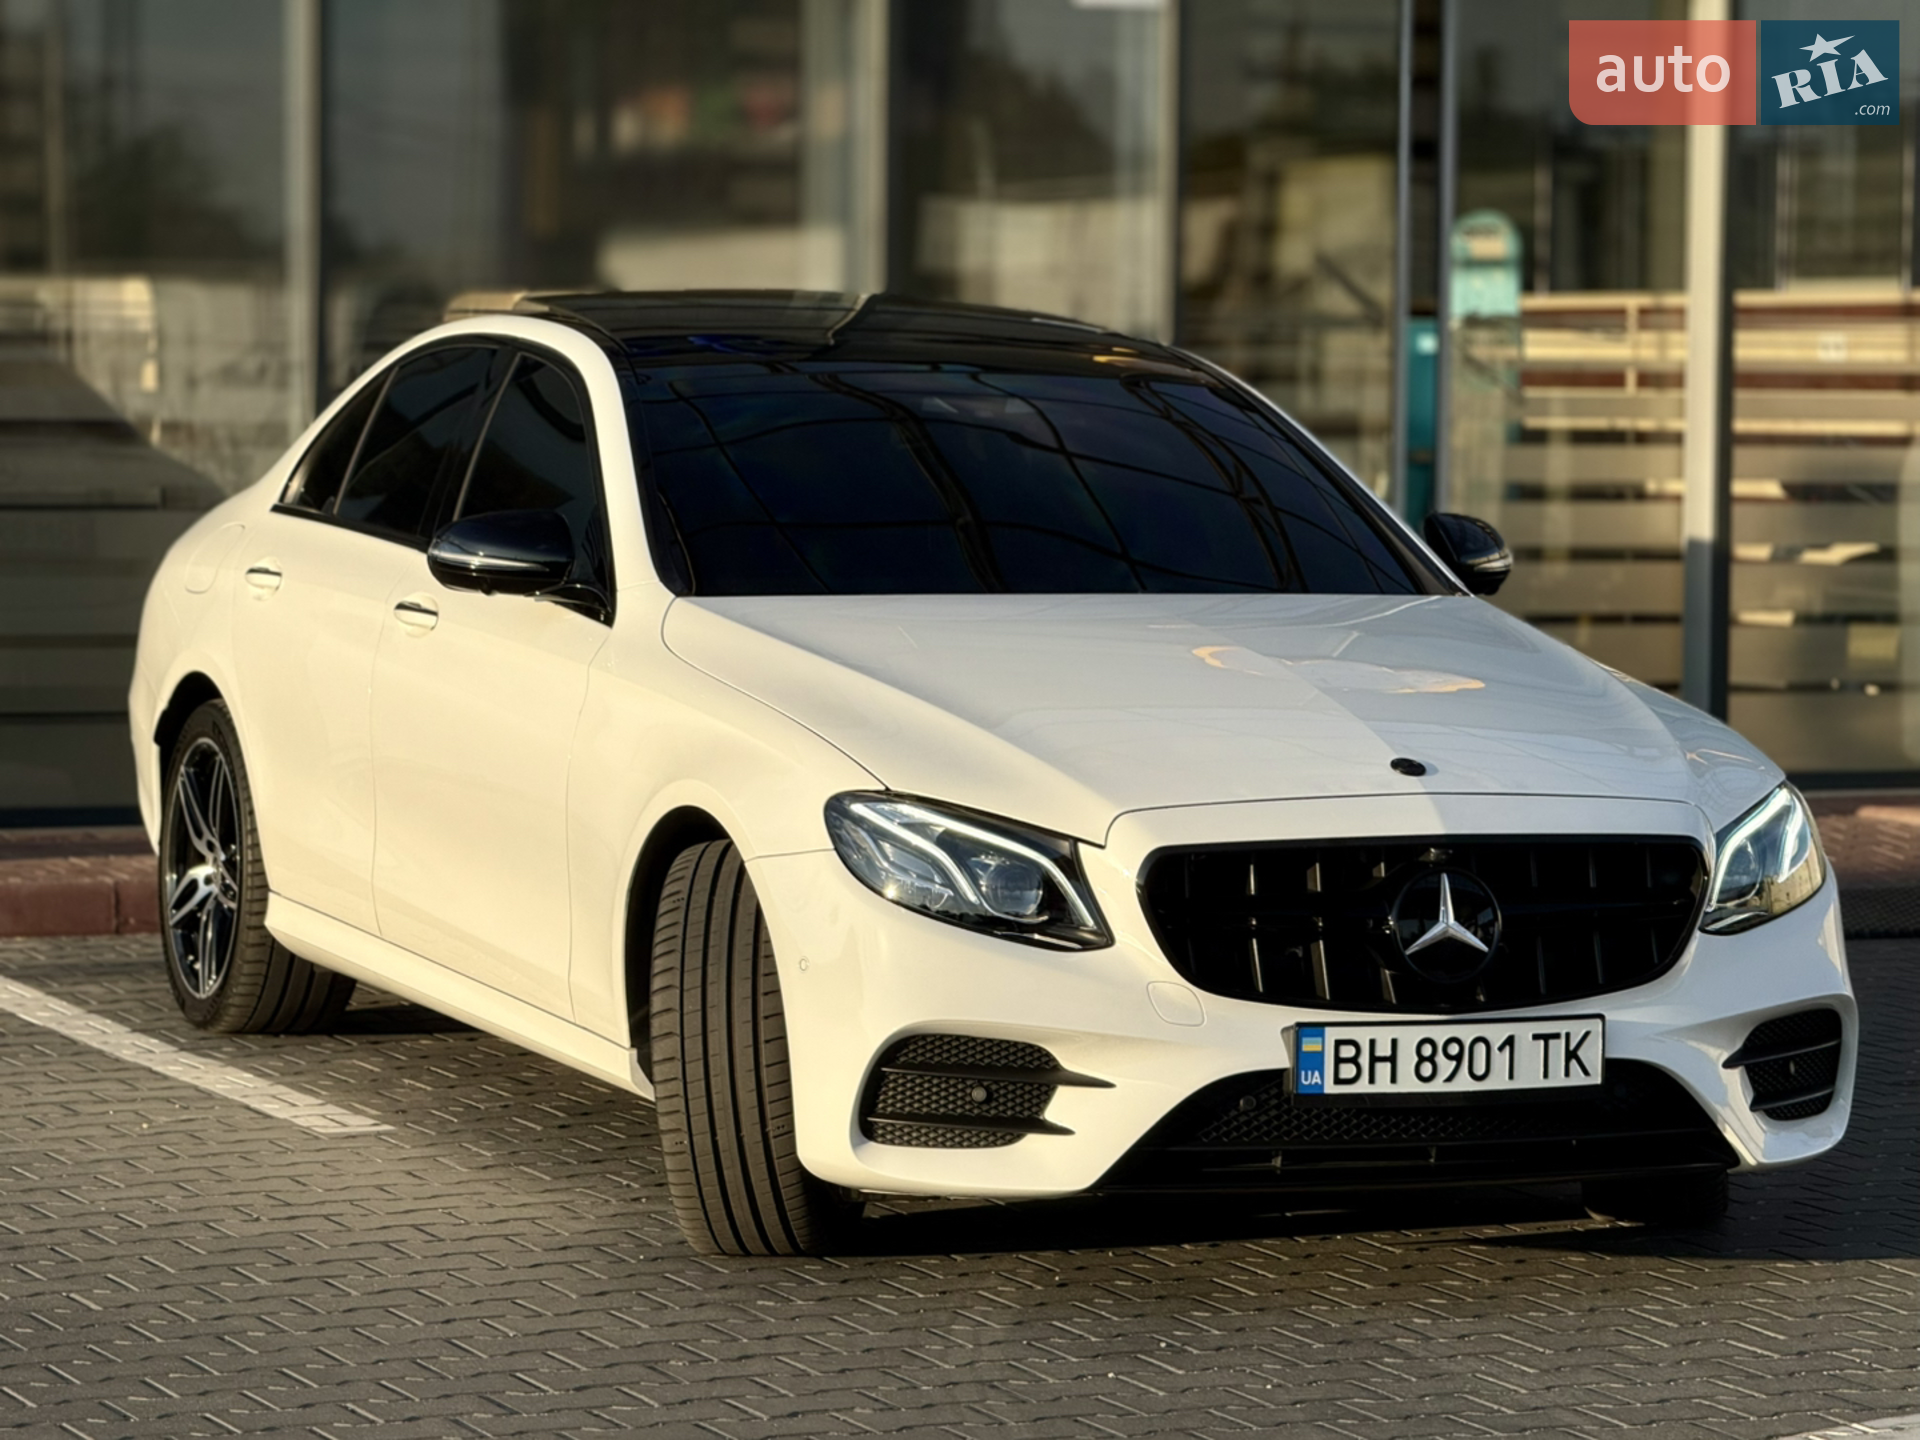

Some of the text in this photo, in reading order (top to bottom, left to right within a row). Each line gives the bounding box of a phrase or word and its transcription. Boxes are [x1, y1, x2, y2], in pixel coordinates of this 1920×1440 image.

[1333, 1030, 1592, 1085] BH 8901 TK
[1301, 1070, 1322, 1085] UA
